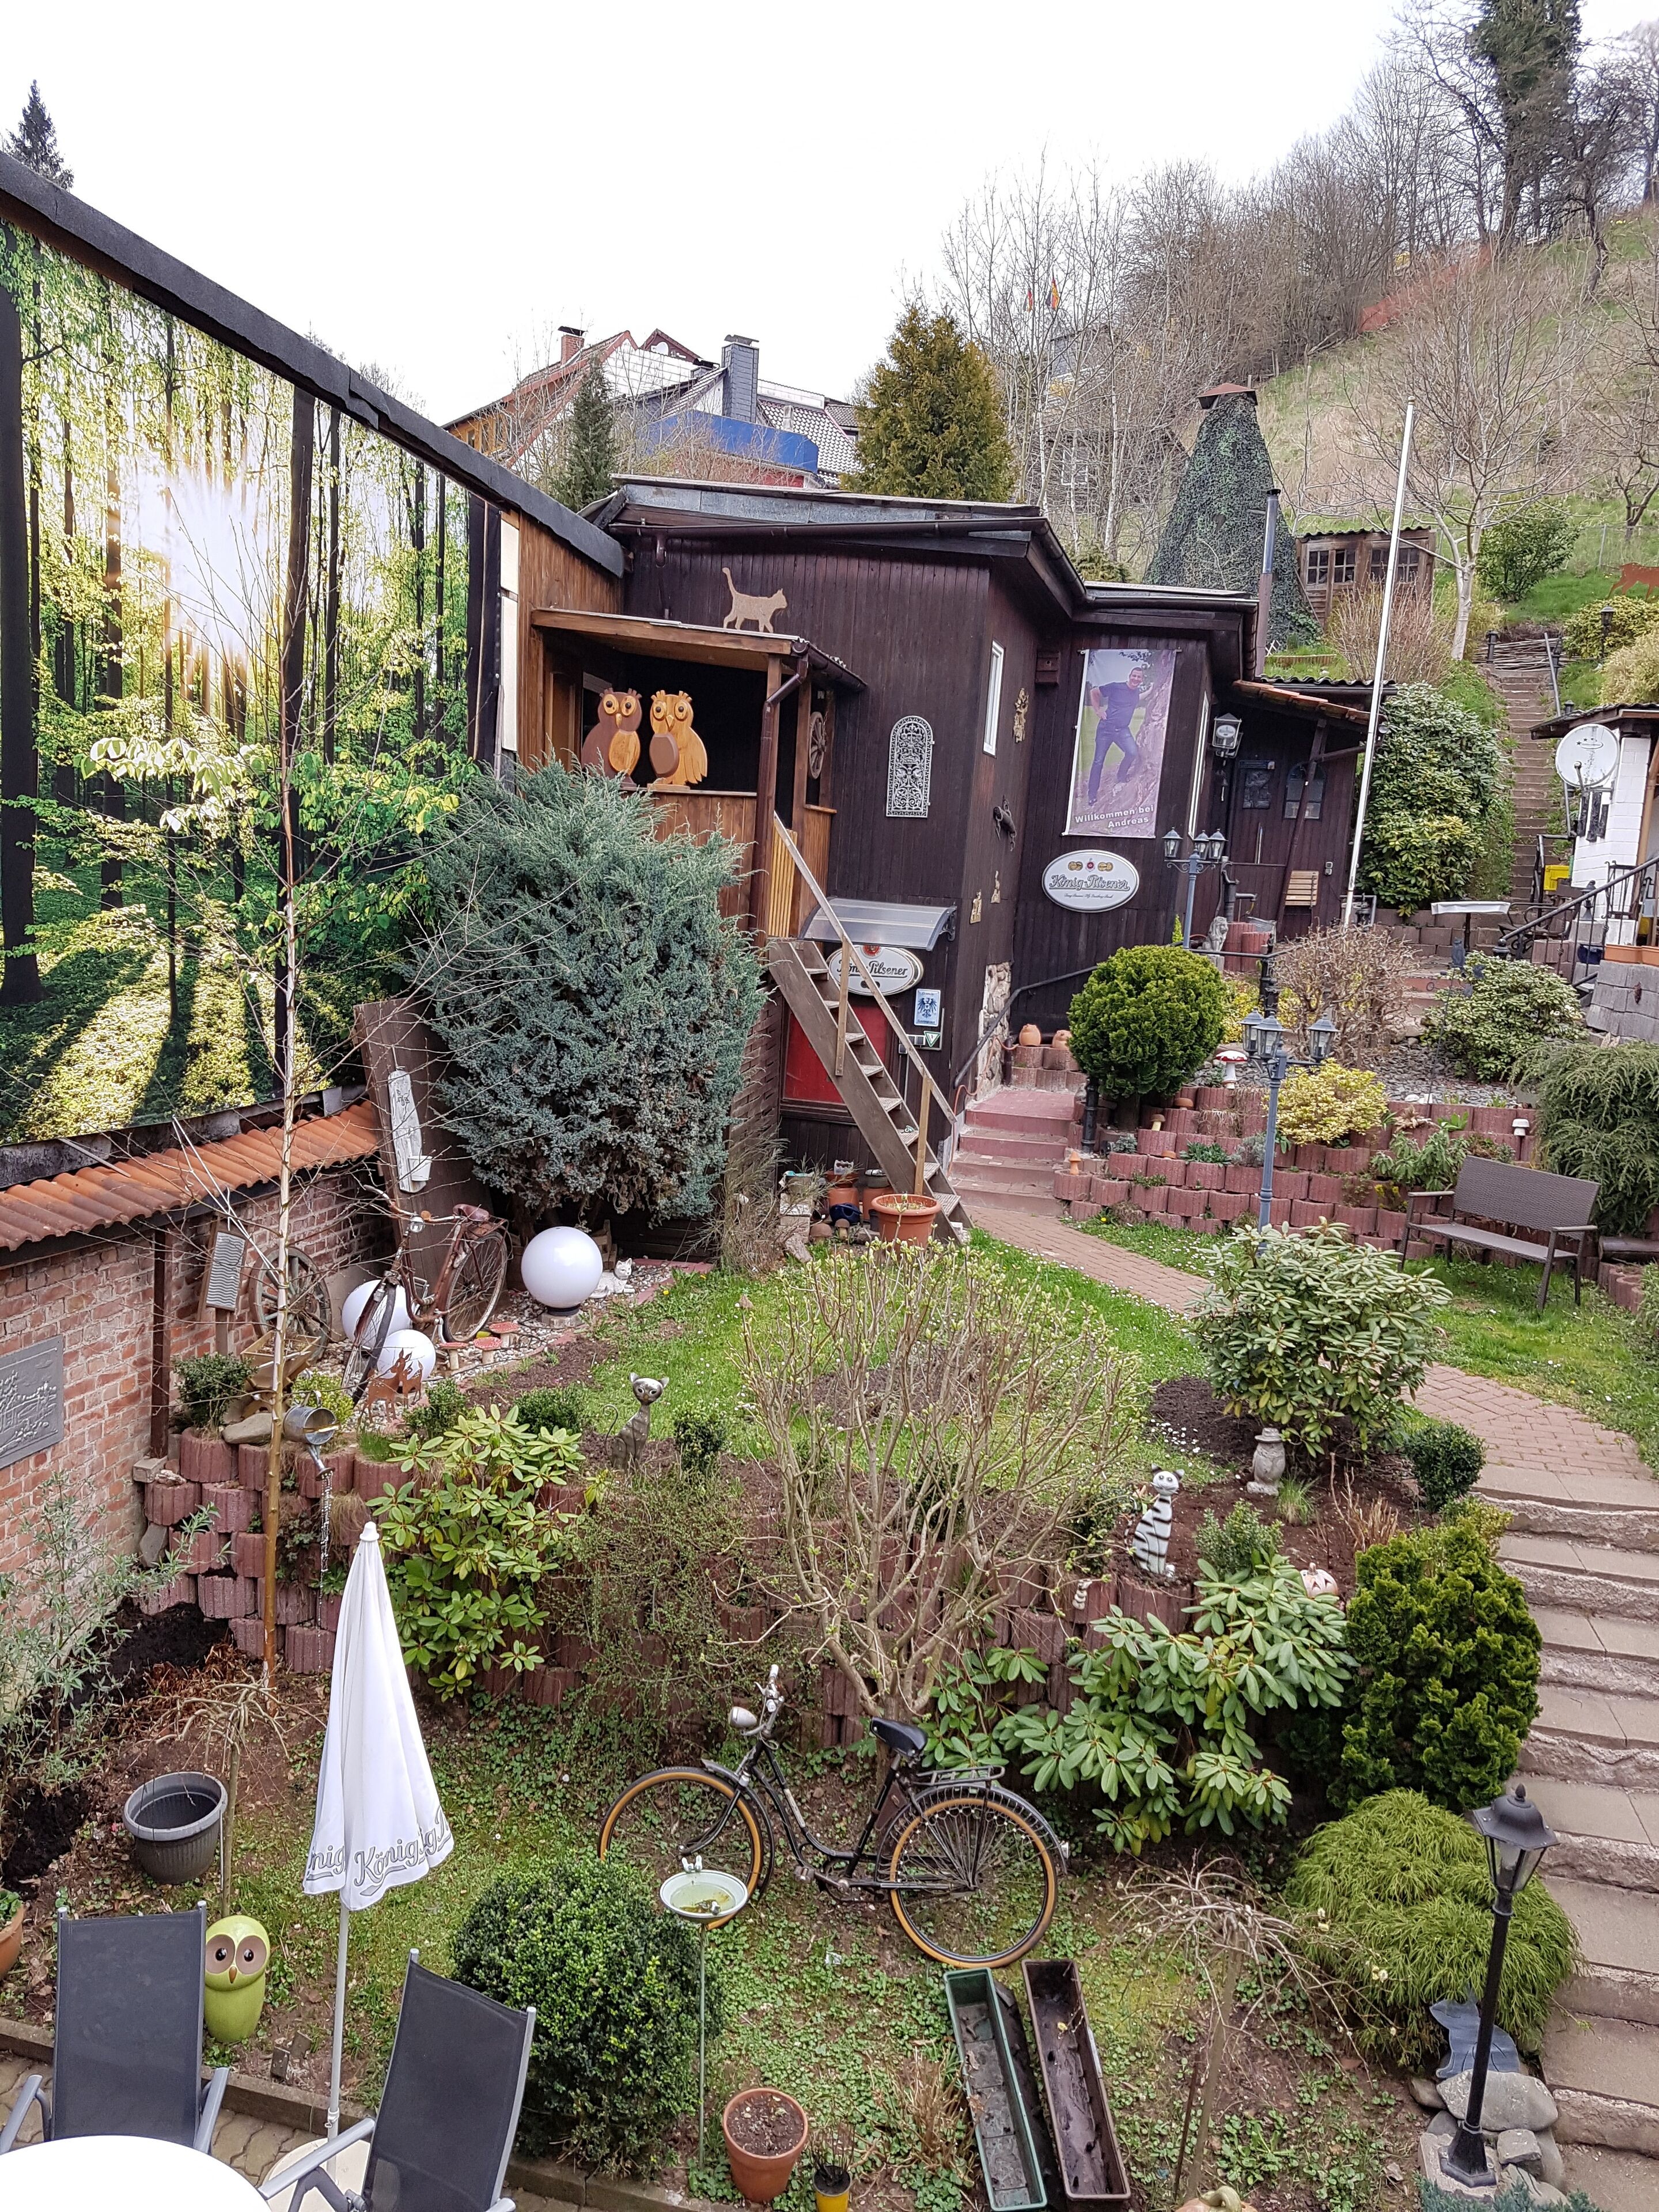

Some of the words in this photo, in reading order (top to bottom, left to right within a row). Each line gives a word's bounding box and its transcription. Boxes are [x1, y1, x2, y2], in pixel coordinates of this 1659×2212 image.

[1075, 809, 1135, 824] Willkommen
[1138, 805, 1154, 814] bei
[1108, 816, 1149, 828] Andreas
[353, 1838, 419, 1887] König
